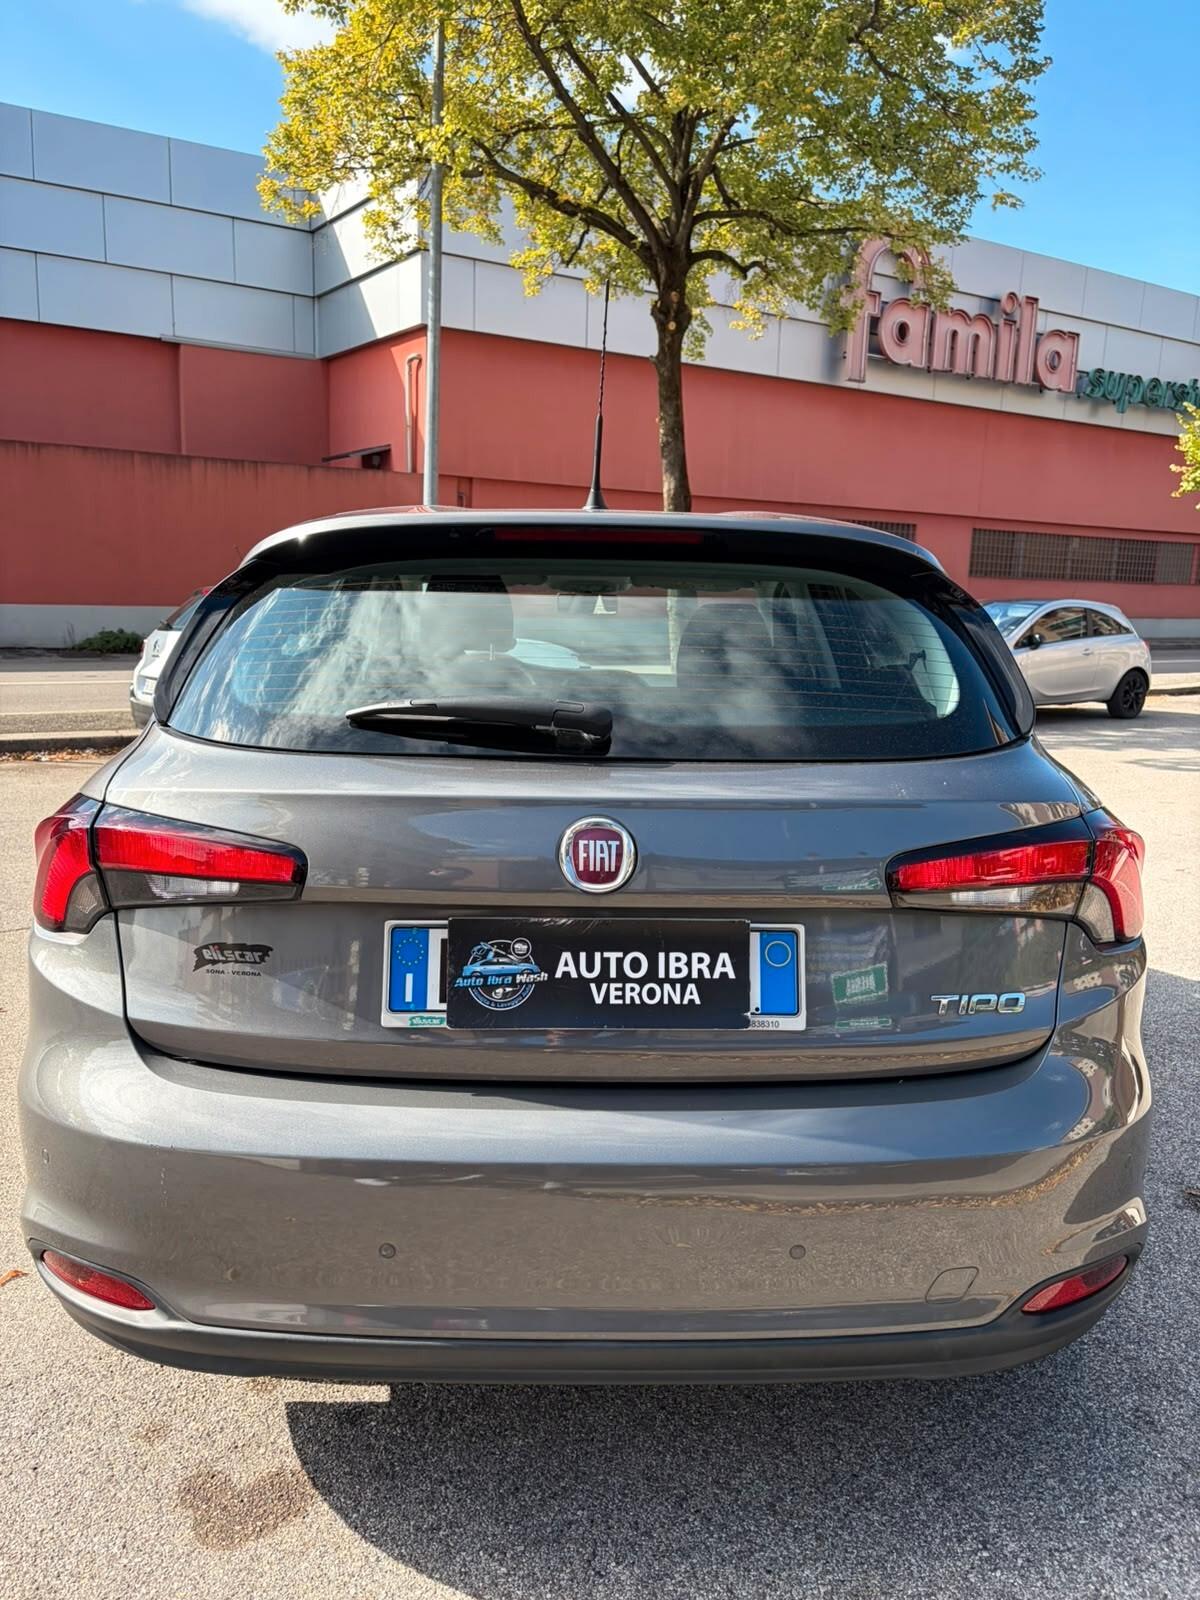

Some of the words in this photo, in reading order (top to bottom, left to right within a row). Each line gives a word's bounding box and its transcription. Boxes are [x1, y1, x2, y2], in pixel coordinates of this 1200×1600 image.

[845, 237, 1081, 393] famila
[578, 839, 620, 872] FIAT
[554, 951, 649, 979] AUTO
[657, 951, 736, 979] IBRA
[454, 976, 484, 988] Auto
[487, 975, 513, 986] Ibra
[516, 971, 549, 984] Wash
[589, 982, 701, 1005] VERONA
[930, 992, 1026, 1016] TIPO
